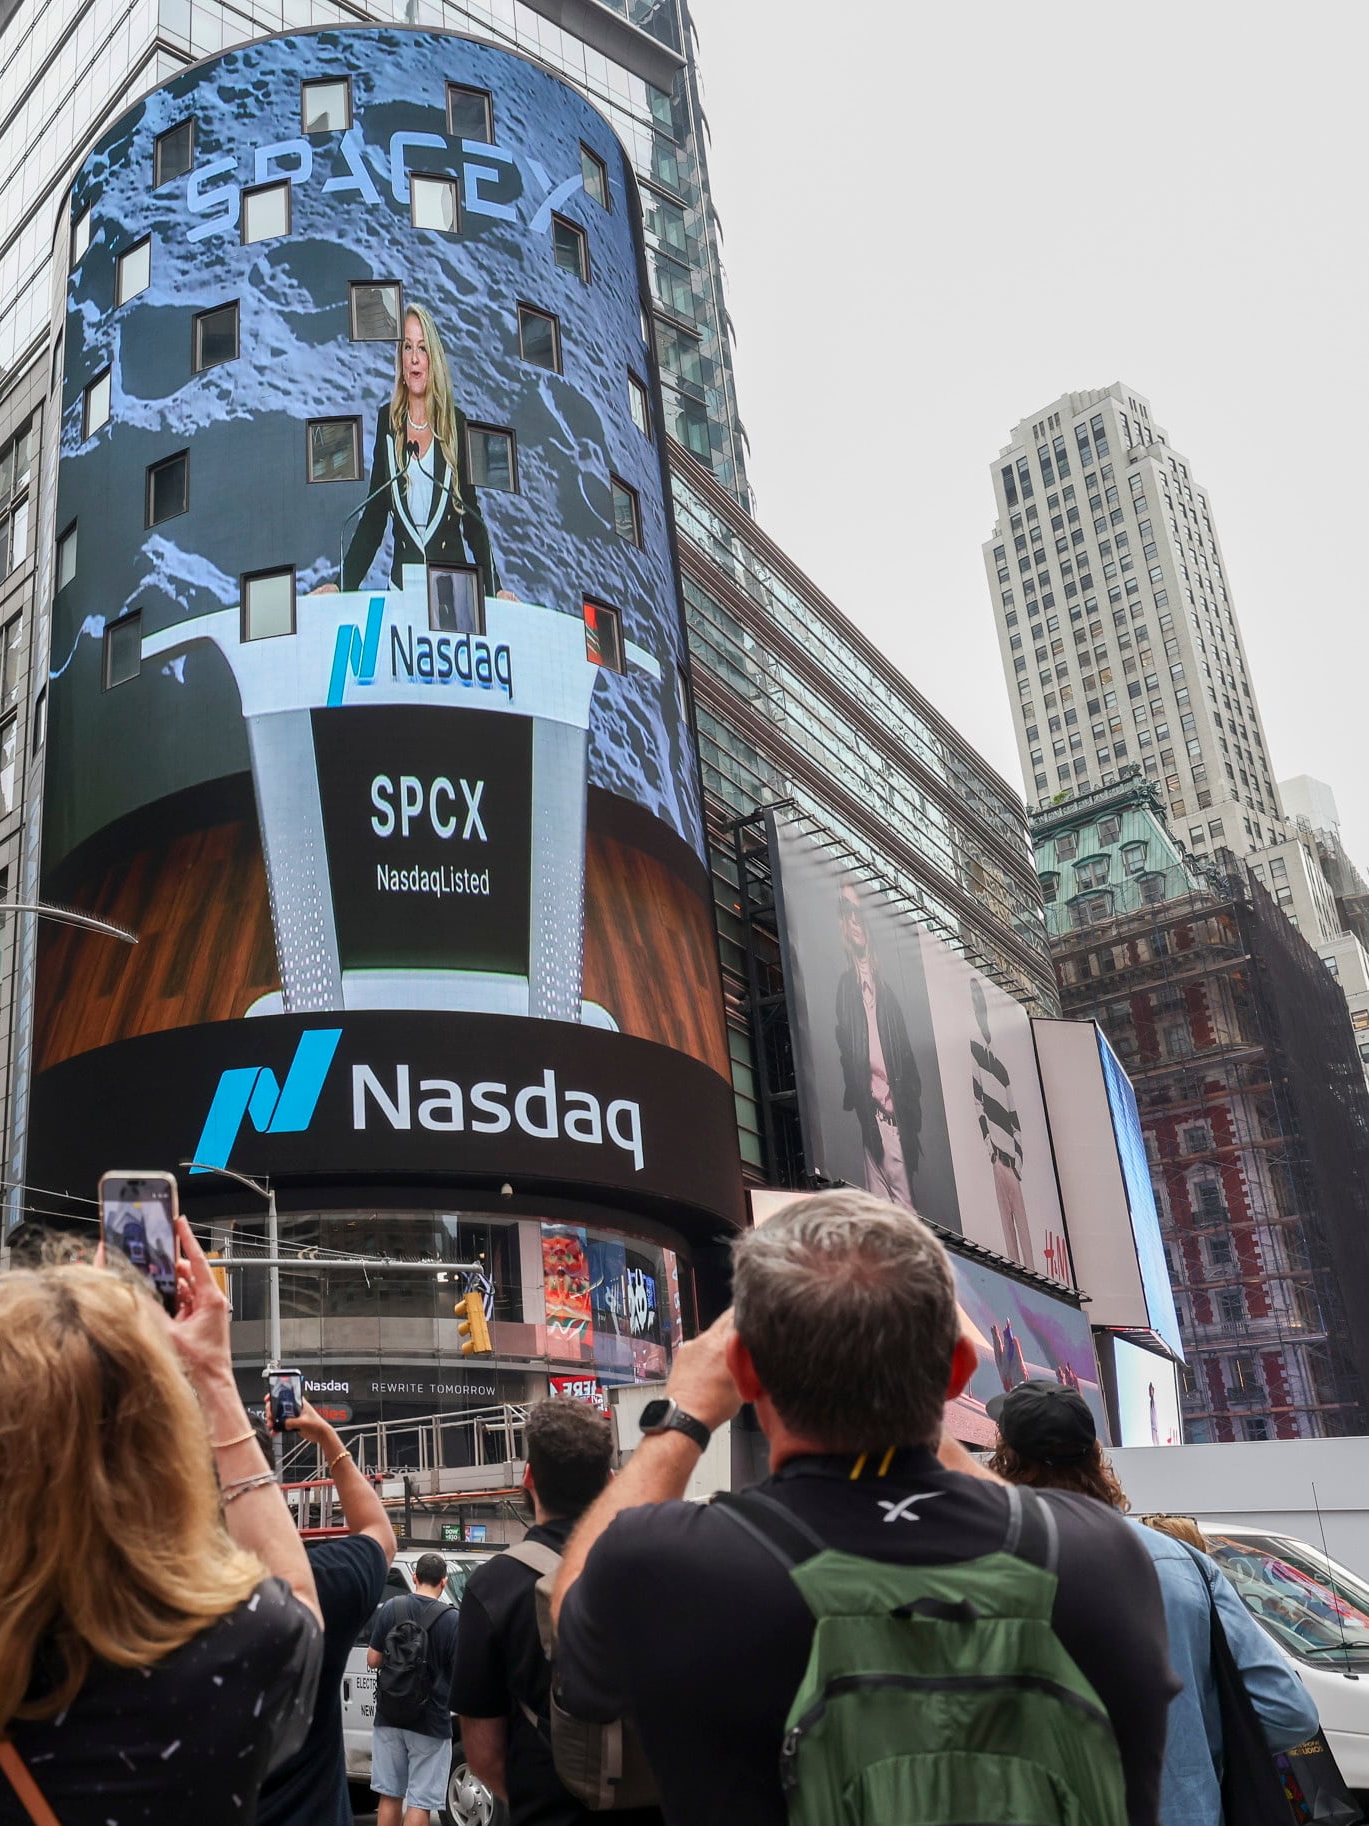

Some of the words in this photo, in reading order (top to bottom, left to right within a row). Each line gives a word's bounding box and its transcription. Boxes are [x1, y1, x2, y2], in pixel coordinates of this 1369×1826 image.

[187, 124, 621, 243] SPACEX
[391, 624, 513, 700] Nasdaq
[371, 774, 488, 841] SPCX
[377, 864, 490, 898] NasdaqListed
[352, 1064, 644, 1171] Nasdaq
[1044, 1229, 1070, 1288] H&M
[304, 1380, 349, 1394] Nasdaq
[371, 1382, 424, 1394] REWRITE
[429, 1384, 496, 1396] TOMORROW
[356, 1677, 378, 1690] ELECTR
[360, 1704, 375, 1717] NEW
